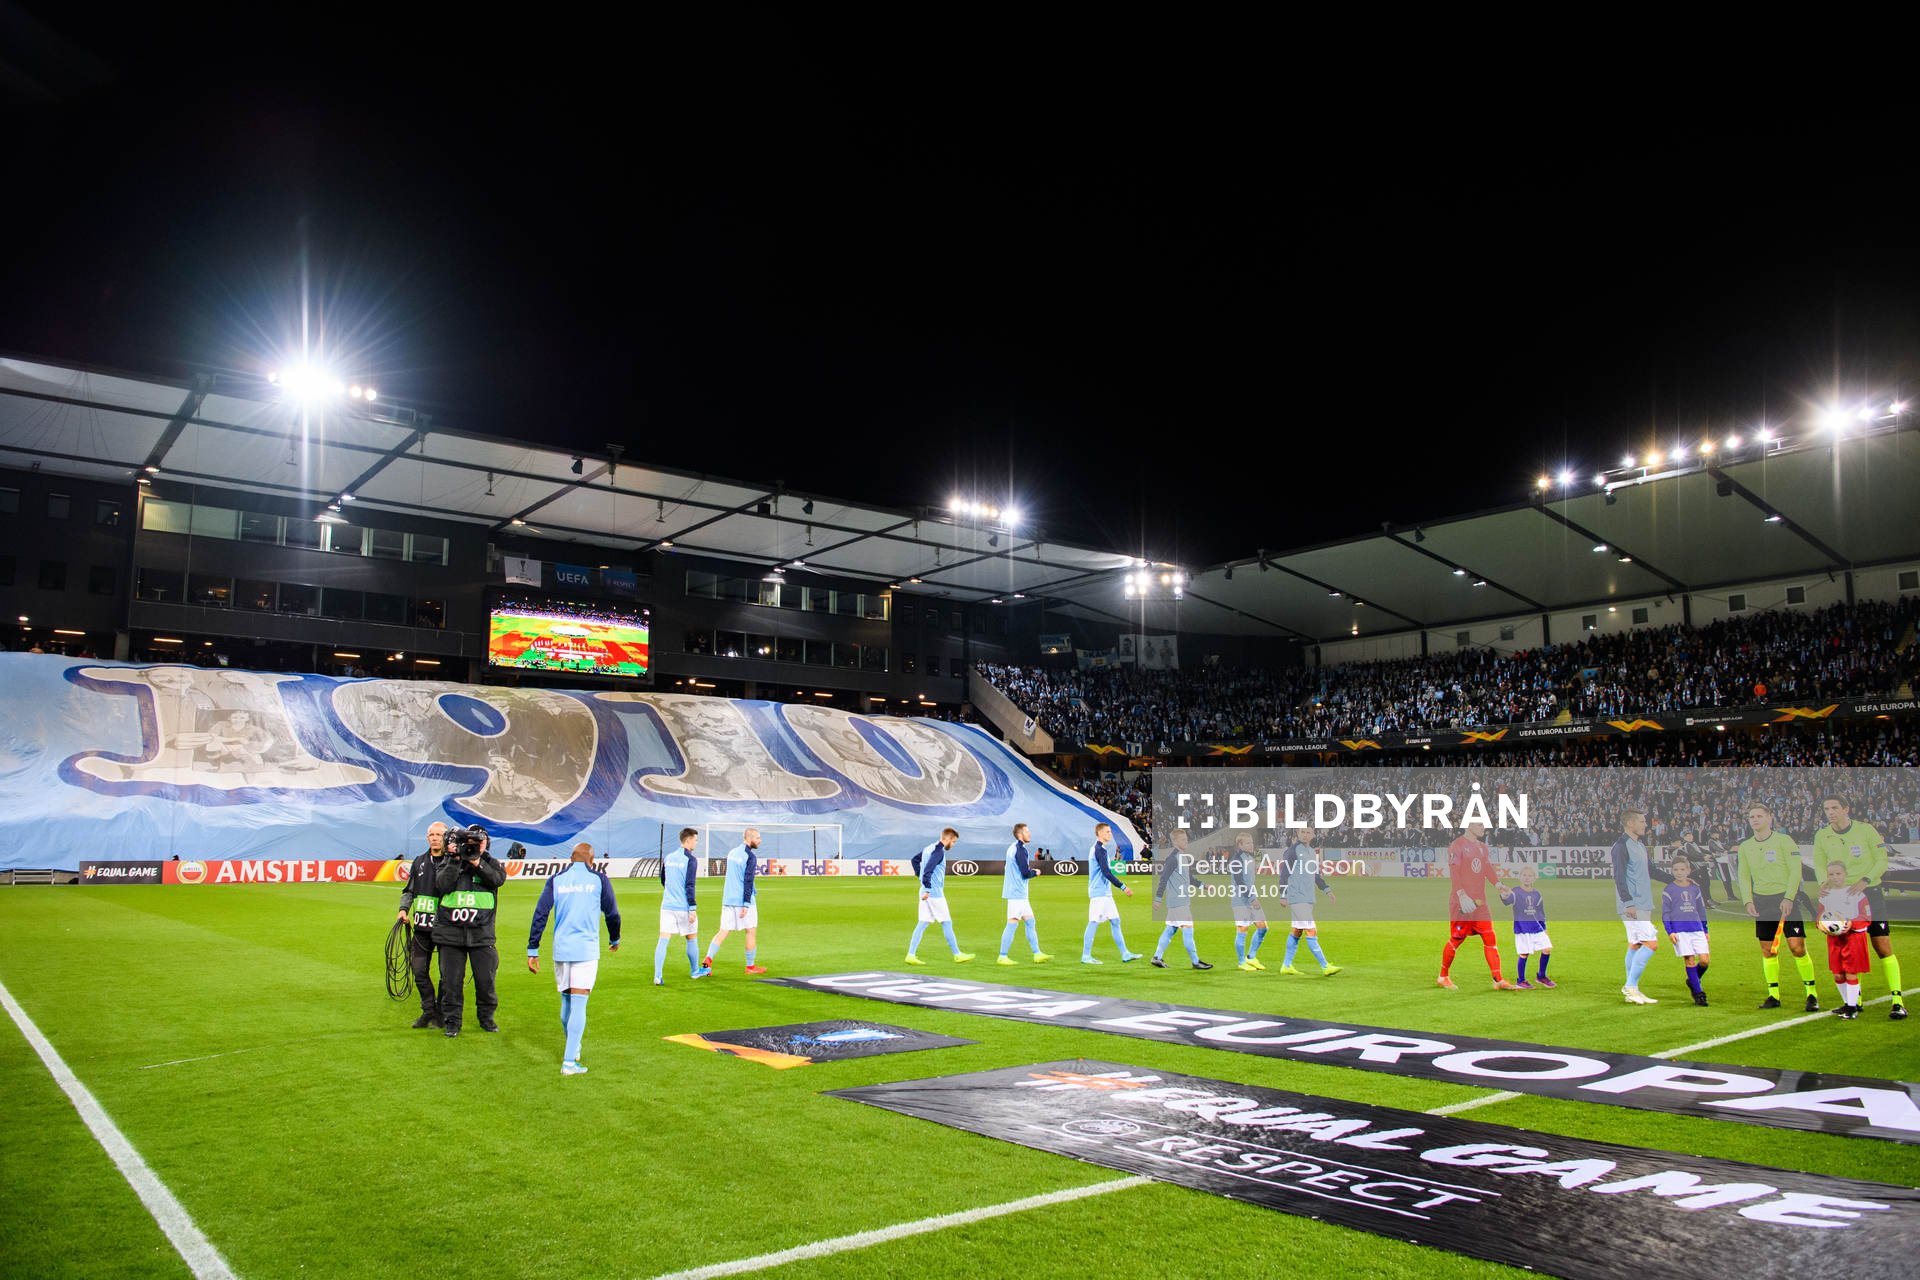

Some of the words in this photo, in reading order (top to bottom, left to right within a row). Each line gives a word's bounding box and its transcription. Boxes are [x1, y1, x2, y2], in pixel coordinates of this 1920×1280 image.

[556, 571, 589, 585] UEFA
[1854, 704, 1879, 713] UEFA
[1880, 702, 1916, 711] EUROPA
[1537, 728, 1563, 736] EUROPA
[1564, 726, 1591, 734] LEAGUE
[57, 663, 1018, 848] 1910
[83, 865, 128, 879] #EQUAL
[128, 865, 158, 878] GAME
[215, 860, 332, 882] AMSTEL
[801, 860, 840, 876] FedEx
[858, 860, 900, 876] FedEx
[1113, 861, 1165, 875] enterp
[1404, 863, 1444, 878] FedEx
[1541, 864, 1614, 879] enterpri
[417, 897, 435, 911] HB
[457, 893, 476, 906] HB
[452, 908, 479, 923] 007
[808, 973, 1101, 1018] UEFA
[1091, 1010, 1920, 1131] EUROPA
[1136, 1134, 1482, 1209] RESPECT
[1420, 1143, 1892, 1229] GAME
